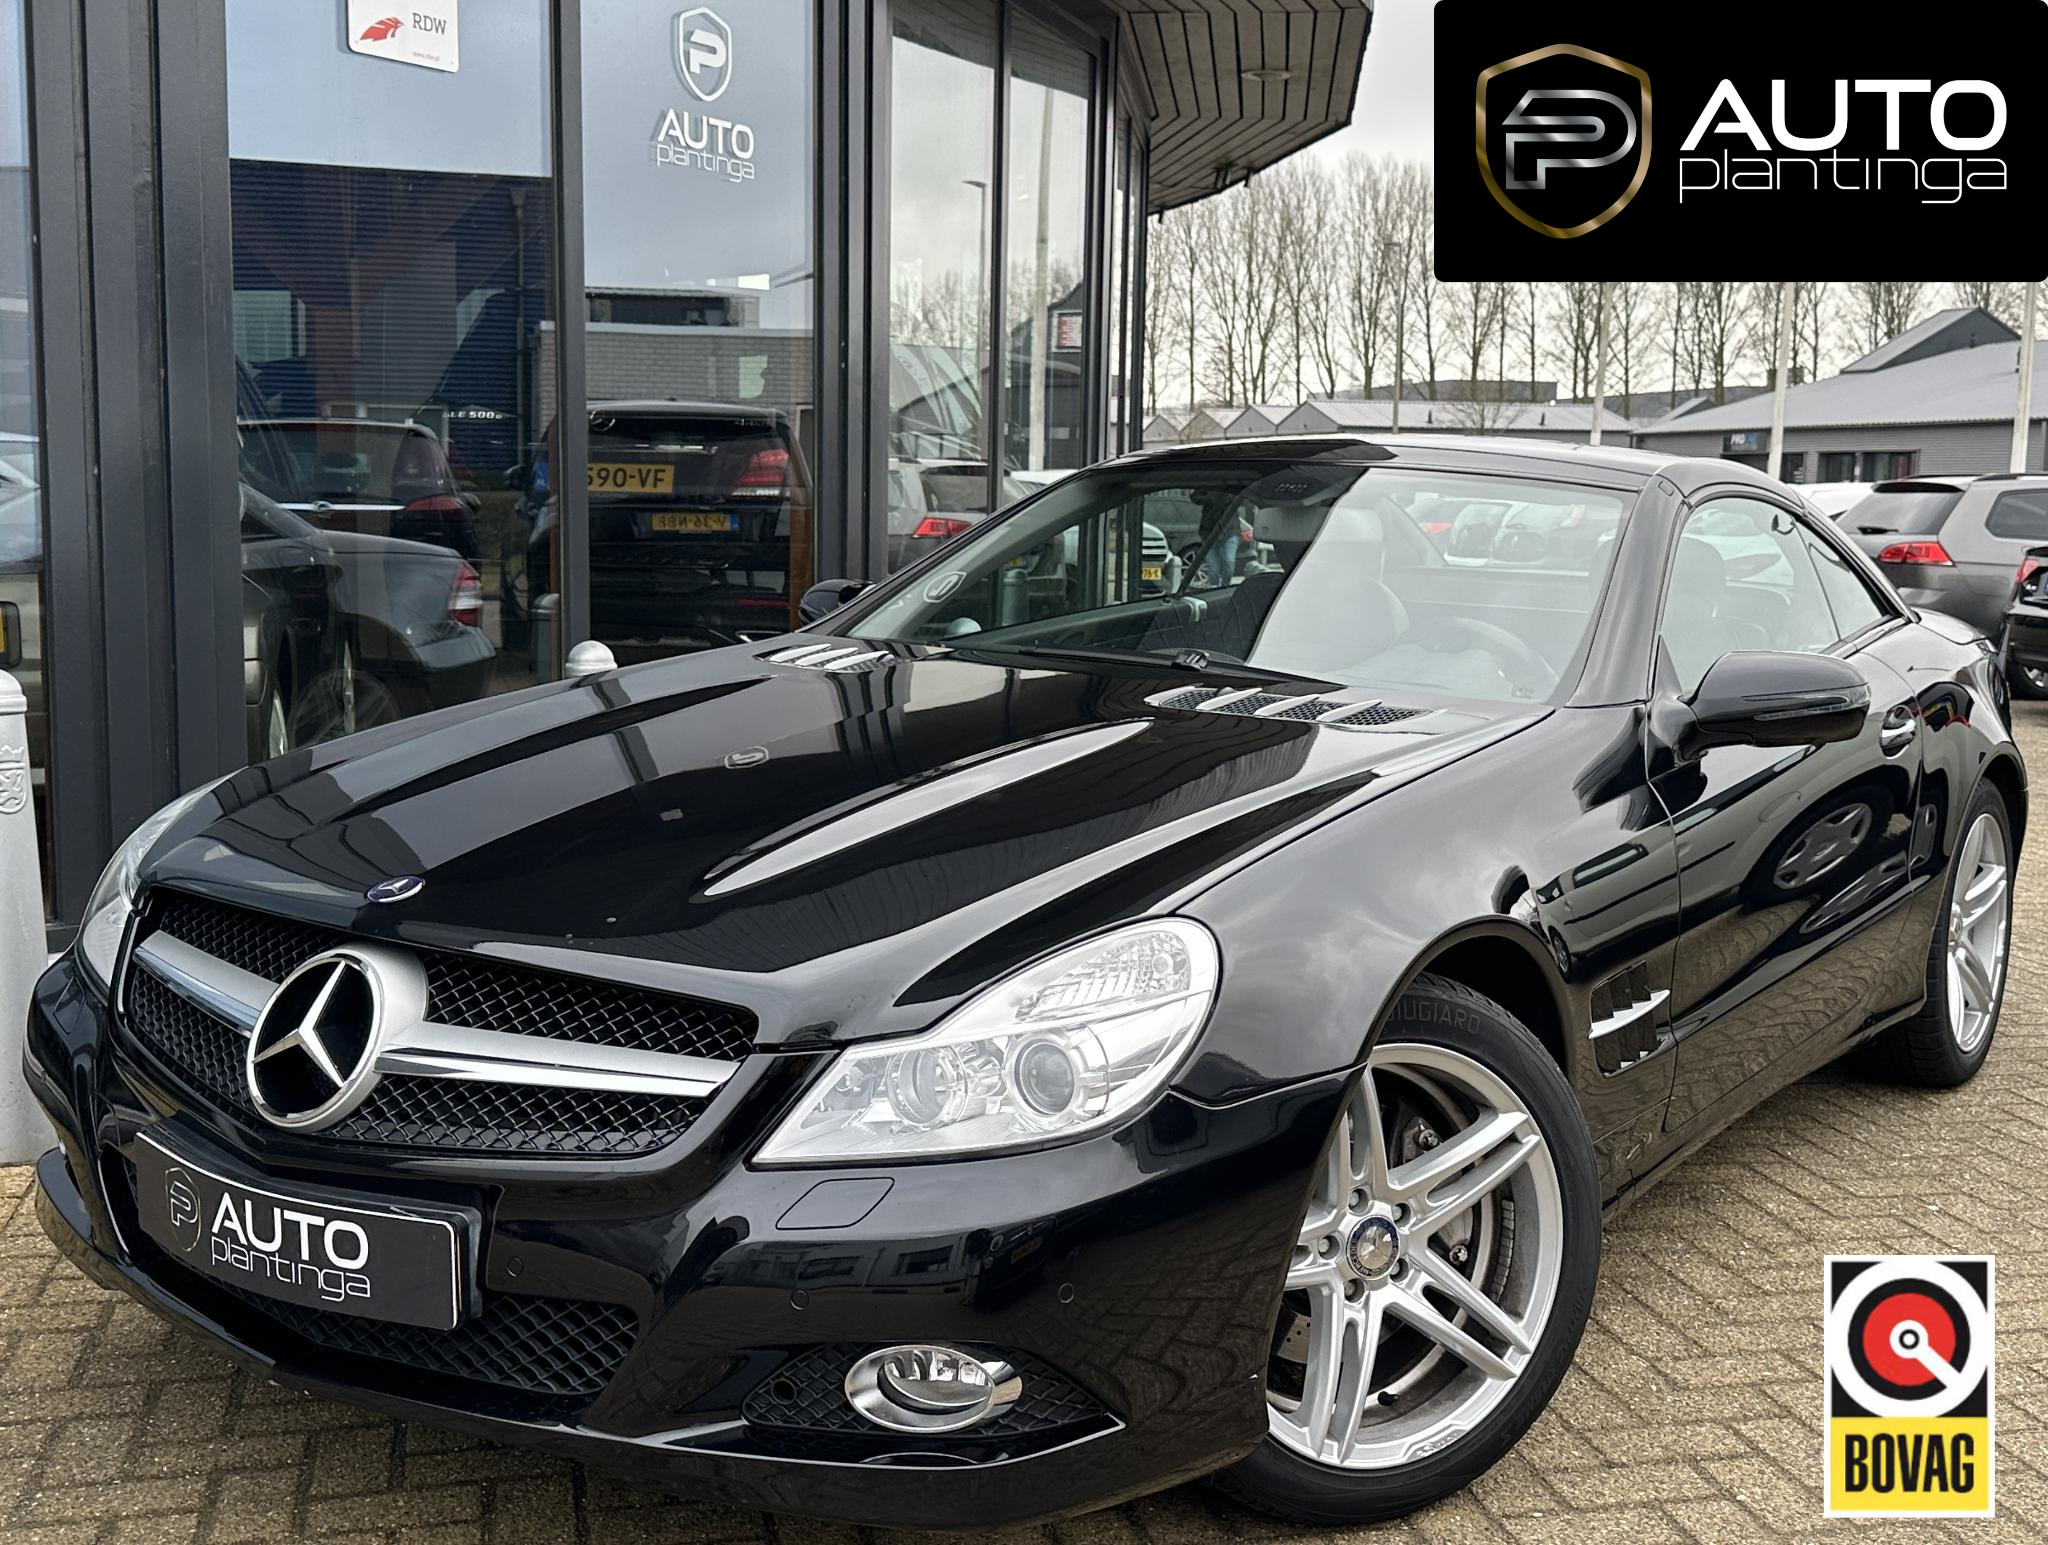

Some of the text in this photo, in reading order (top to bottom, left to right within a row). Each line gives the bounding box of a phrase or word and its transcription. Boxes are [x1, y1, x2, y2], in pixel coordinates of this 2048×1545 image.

[412, 12, 446, 35] RDW
[657, 108, 755, 159] AUTO
[656, 143, 755, 183] plantinga
[211, 1192, 369, 1269] AUTO
[211, 1235, 370, 1301] plantinga
